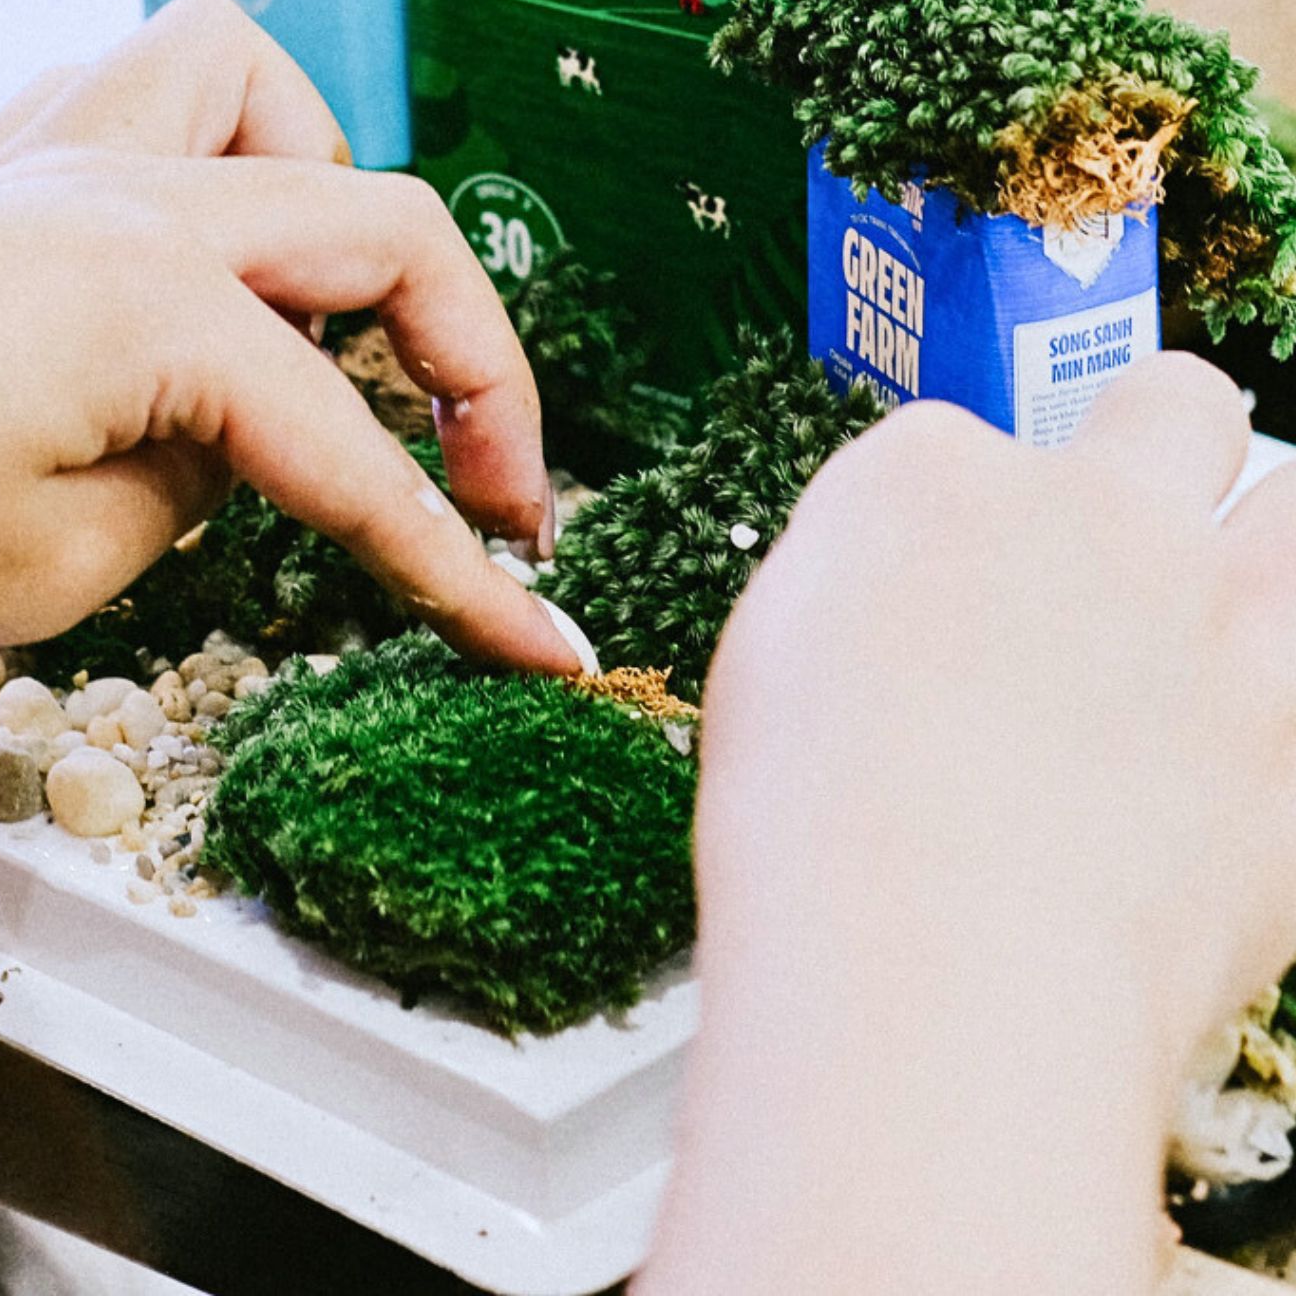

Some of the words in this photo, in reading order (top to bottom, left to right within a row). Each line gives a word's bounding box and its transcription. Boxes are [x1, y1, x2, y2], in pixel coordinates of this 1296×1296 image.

[479, 210, 533, 280] 30
[842, 226, 926, 339] GREEN
[845, 289, 920, 400] FARM
